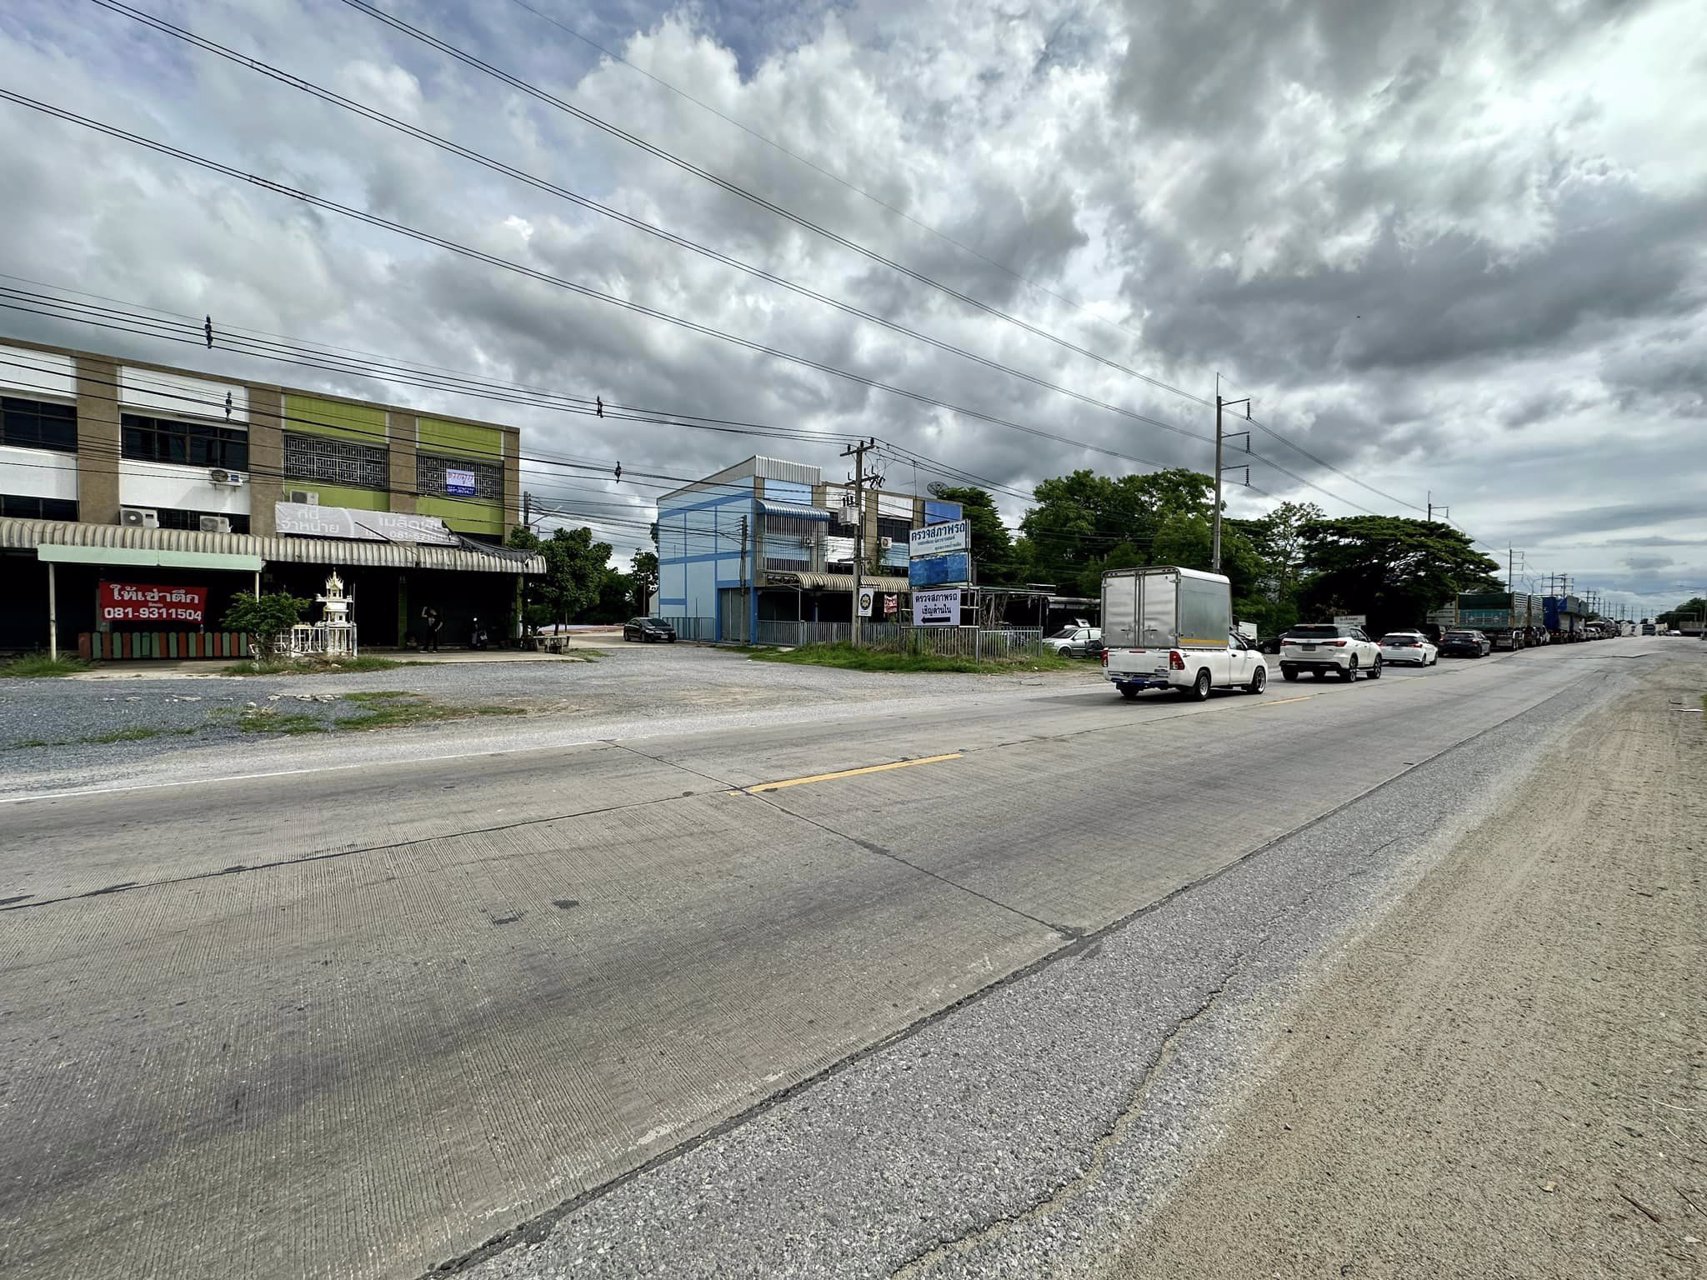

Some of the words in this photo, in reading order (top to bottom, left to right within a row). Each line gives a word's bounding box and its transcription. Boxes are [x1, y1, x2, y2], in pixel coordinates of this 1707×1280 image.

[911, 522, 965, 541] ตรวจสภาพรถ
[110, 584, 199, 604] ให้เช่าตึก
[915, 593, 958, 603] ตรวจสภาพรถ
[104, 607, 202, 621] 081-9311504
